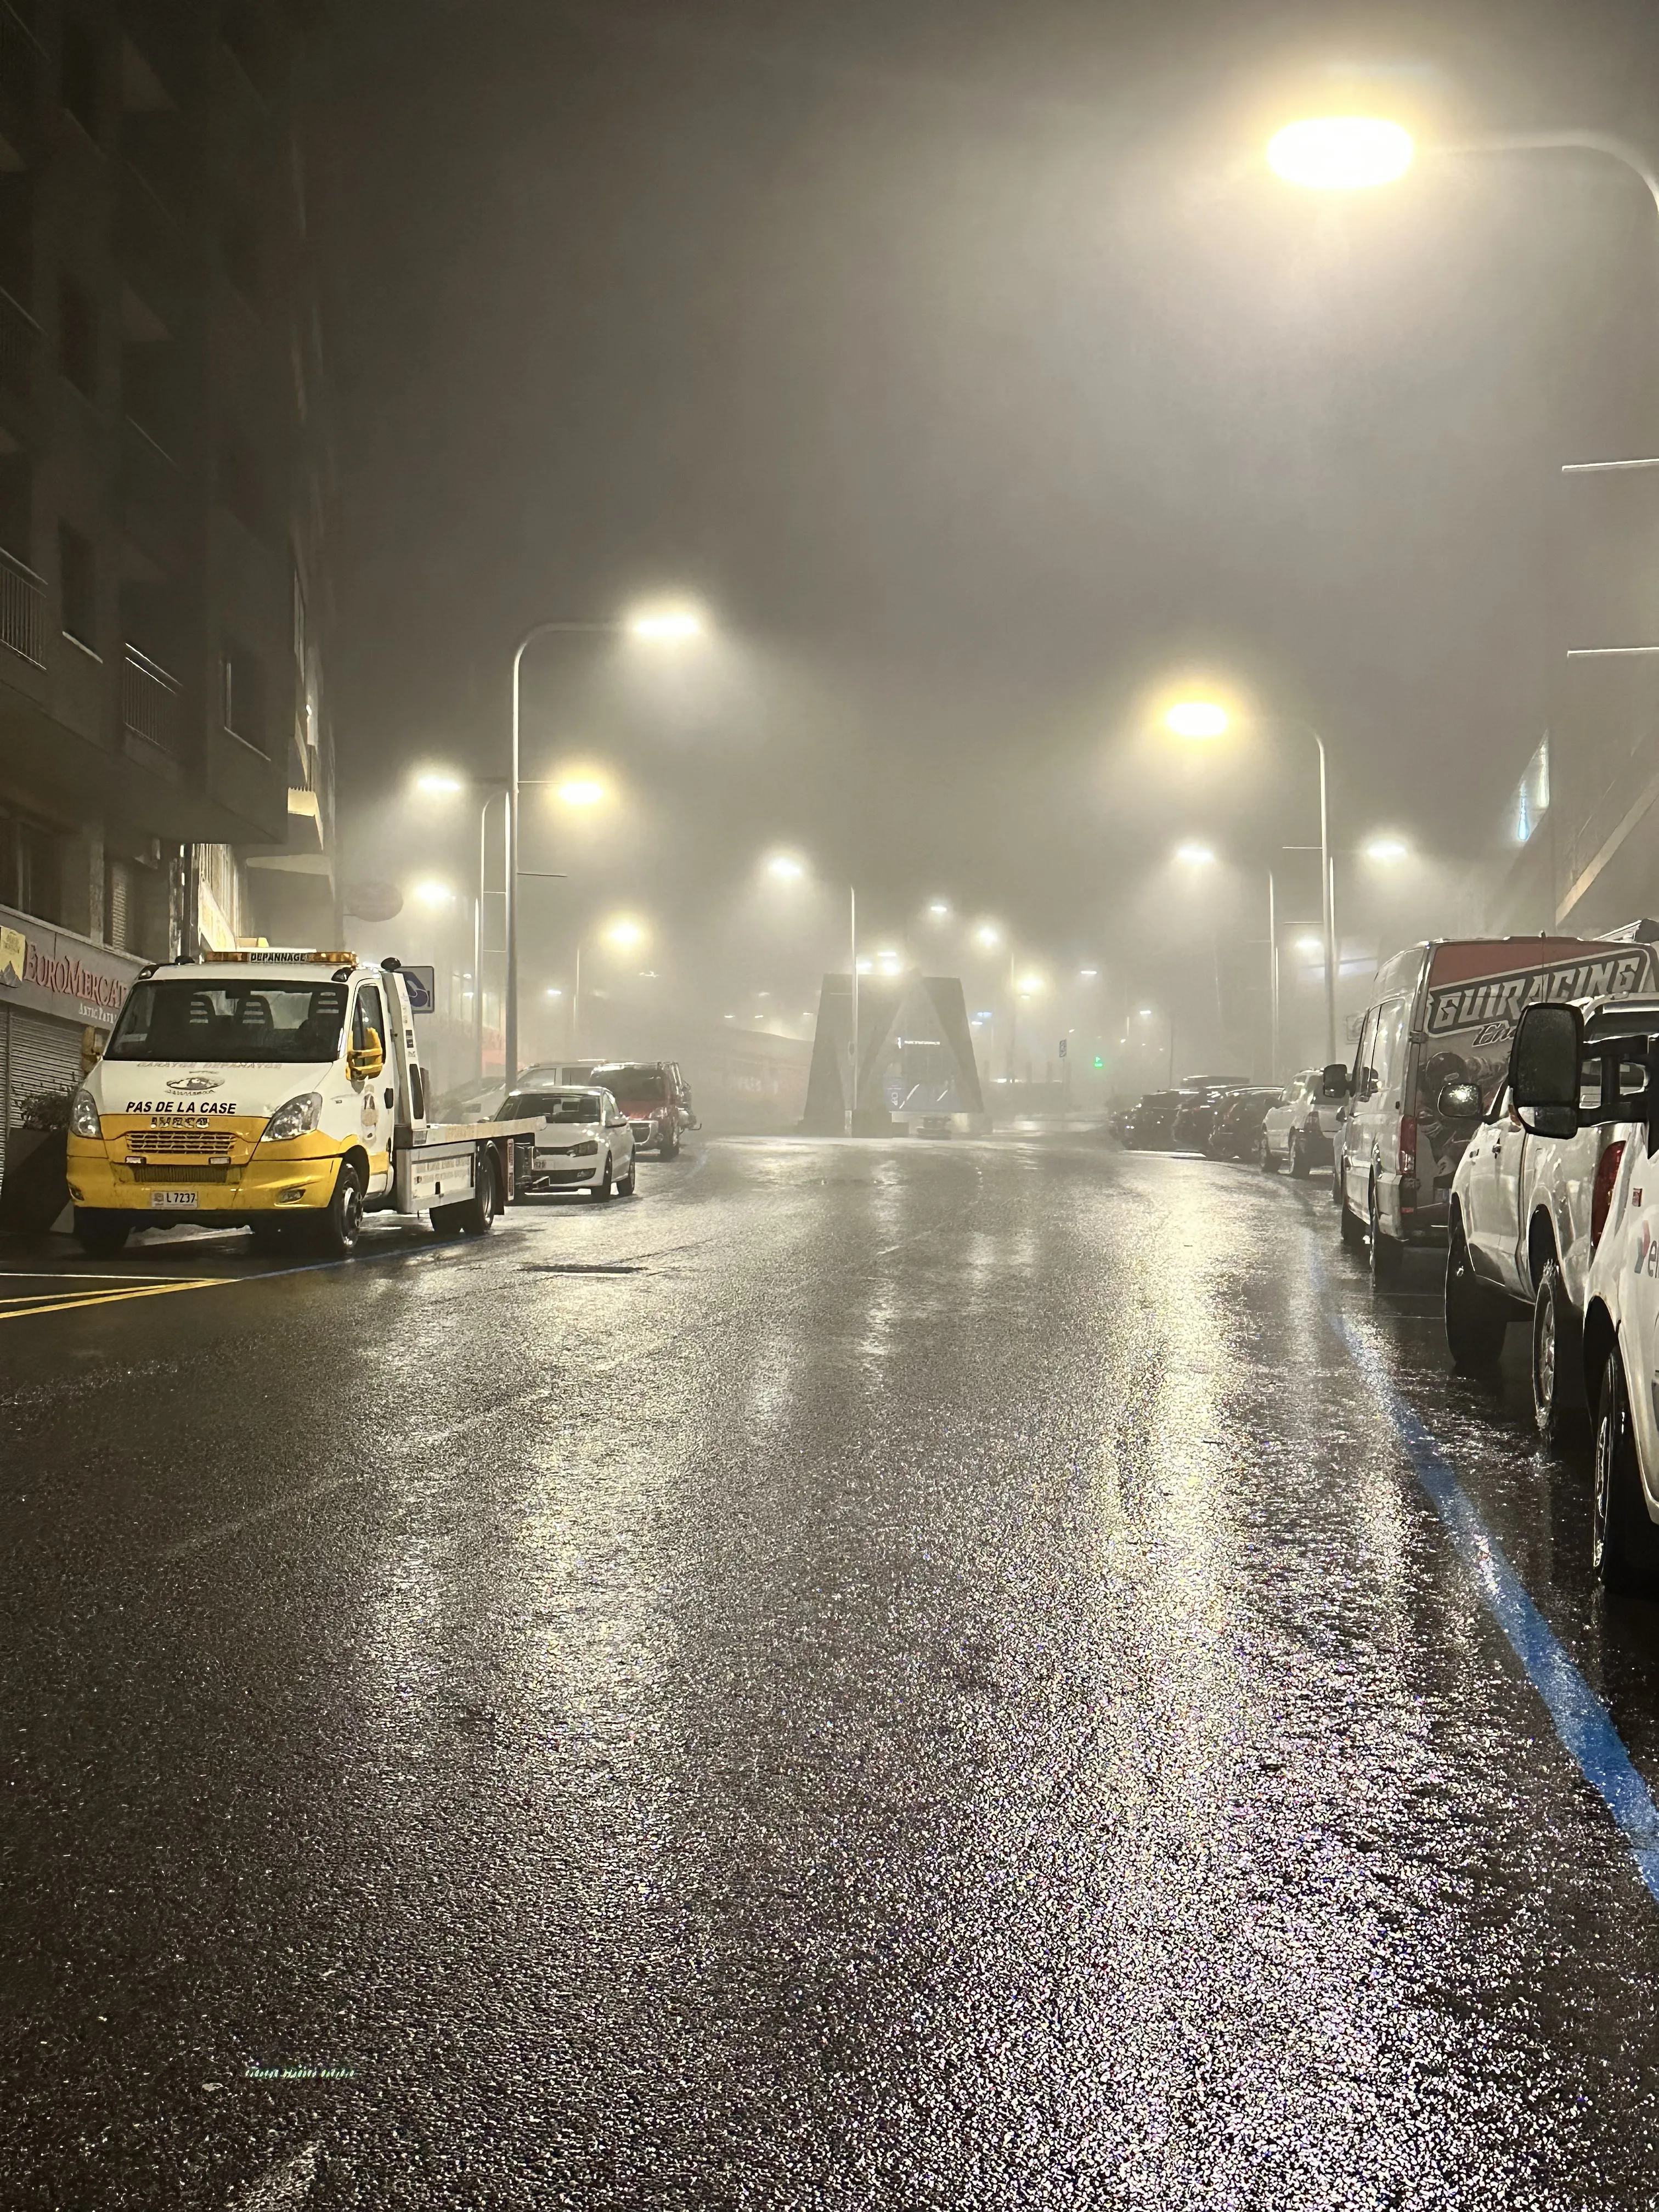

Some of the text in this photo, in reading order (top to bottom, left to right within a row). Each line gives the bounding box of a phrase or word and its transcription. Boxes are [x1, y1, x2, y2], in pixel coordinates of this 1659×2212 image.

[1434, 957, 1640, 1029] GUIRACING
[126, 1101, 236, 1114] PAS DE LA CASE
